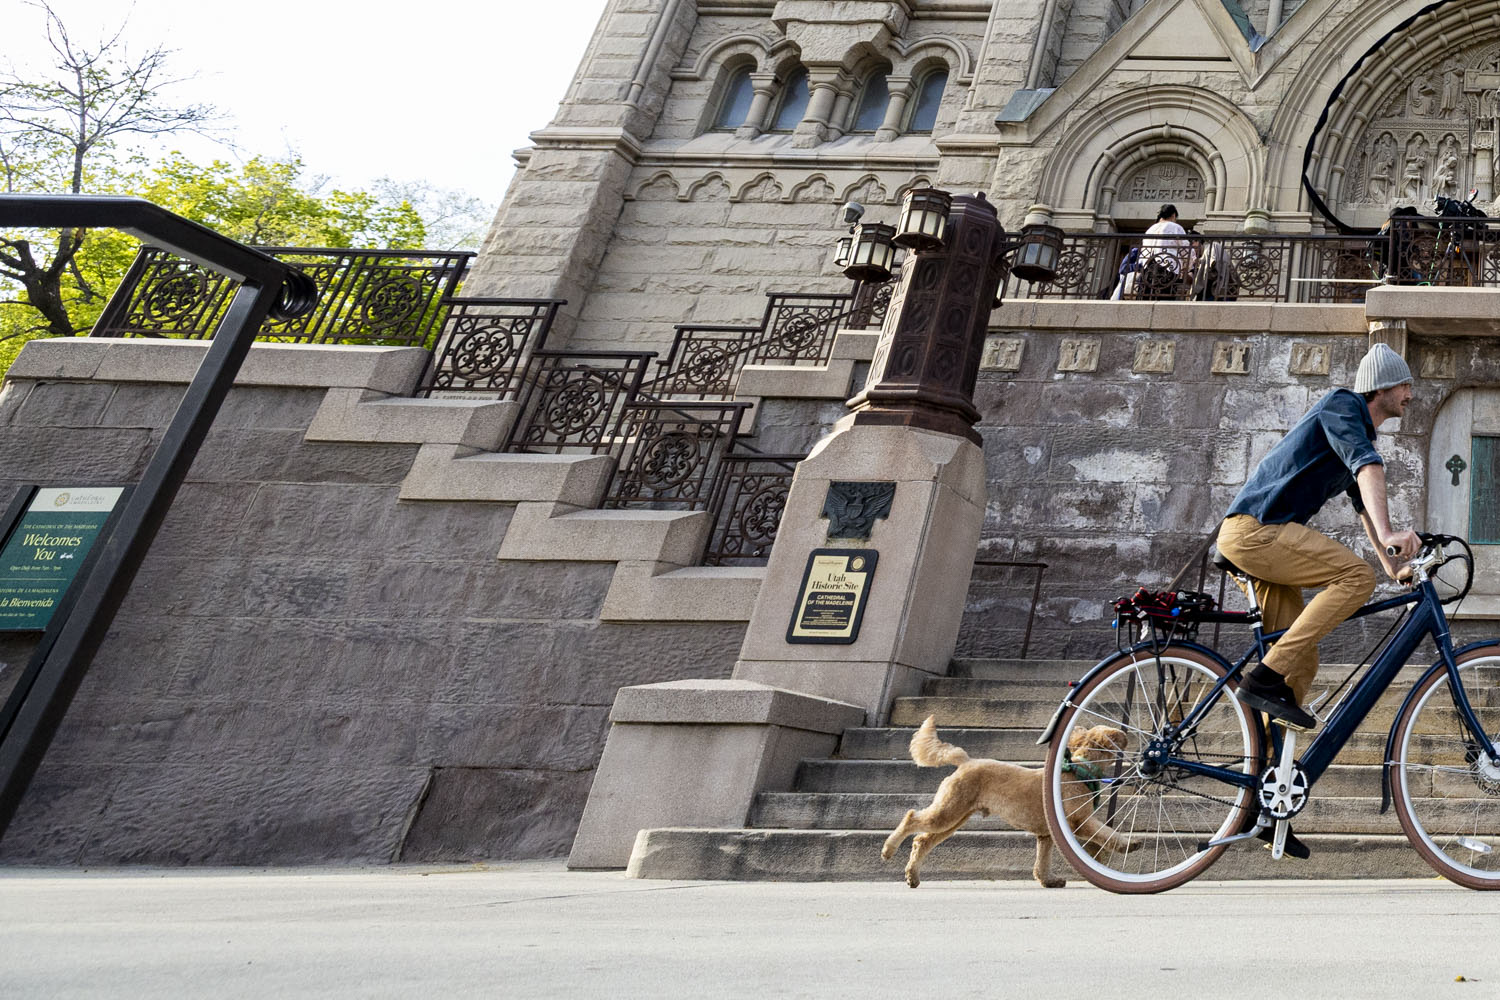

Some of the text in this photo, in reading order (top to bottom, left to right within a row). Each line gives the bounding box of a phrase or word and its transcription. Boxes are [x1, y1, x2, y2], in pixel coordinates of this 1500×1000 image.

[23, 533, 82, 546] Welcomes
[34, 547, 56, 560] You
[828, 573, 846, 582] Utah
[812, 580, 859, 590] Historic Site
[9, 598, 54, 607] Bienvenida
